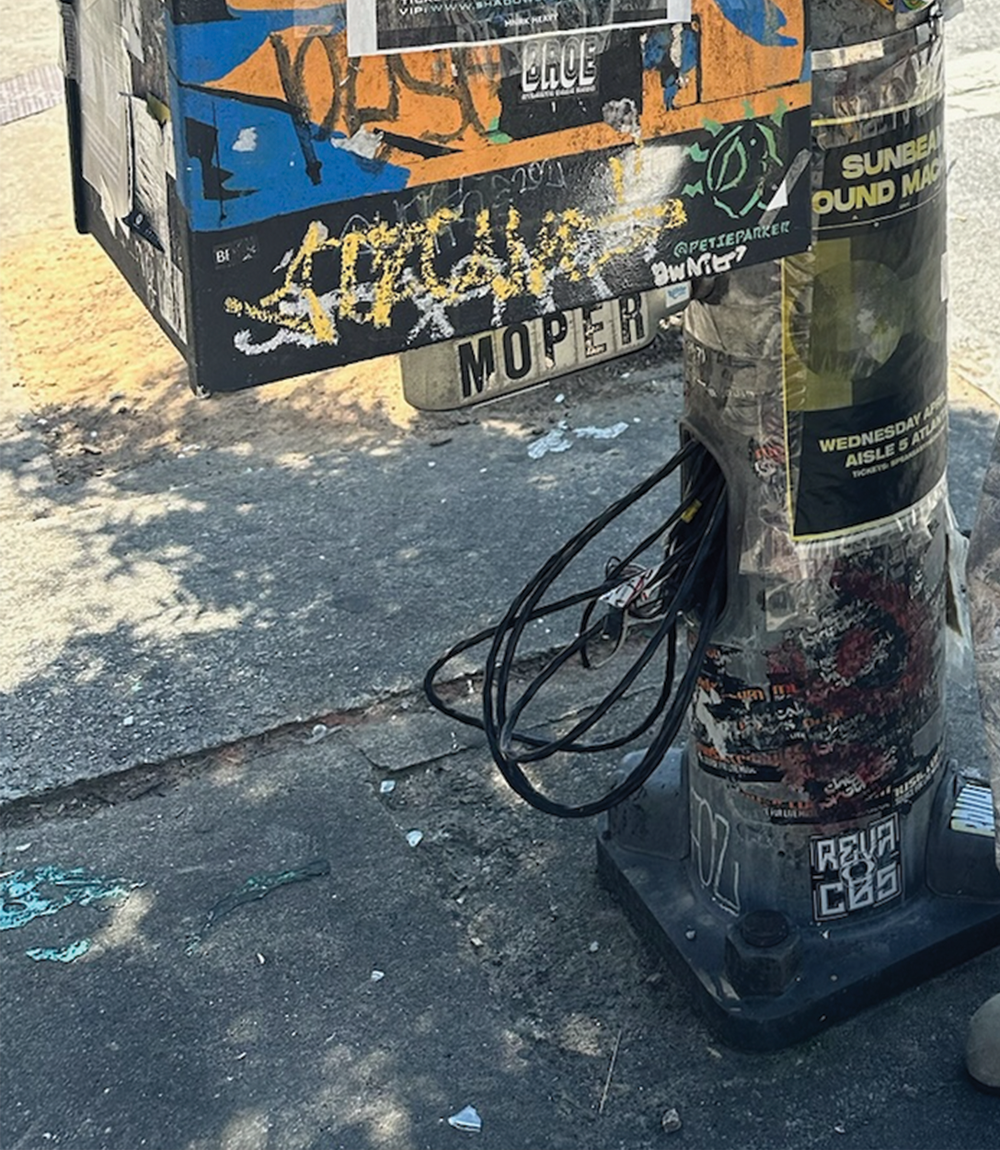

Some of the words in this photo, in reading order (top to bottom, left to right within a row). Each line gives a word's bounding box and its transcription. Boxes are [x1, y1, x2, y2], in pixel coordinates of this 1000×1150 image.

[400, 6, 428, 16] VIP:
[842, 125, 941, 179] SUNBEA
[811, 178, 895, 214] OUND
[901, 157, 941, 198] MAC
[673, 220, 791, 257] @PETIEPARKER
[458, 292, 646, 399] MOPER
[819, 412, 922, 453] WEDNESDAY
[845, 442, 896, 468] AISLE
[898, 437, 909, 452] 5
